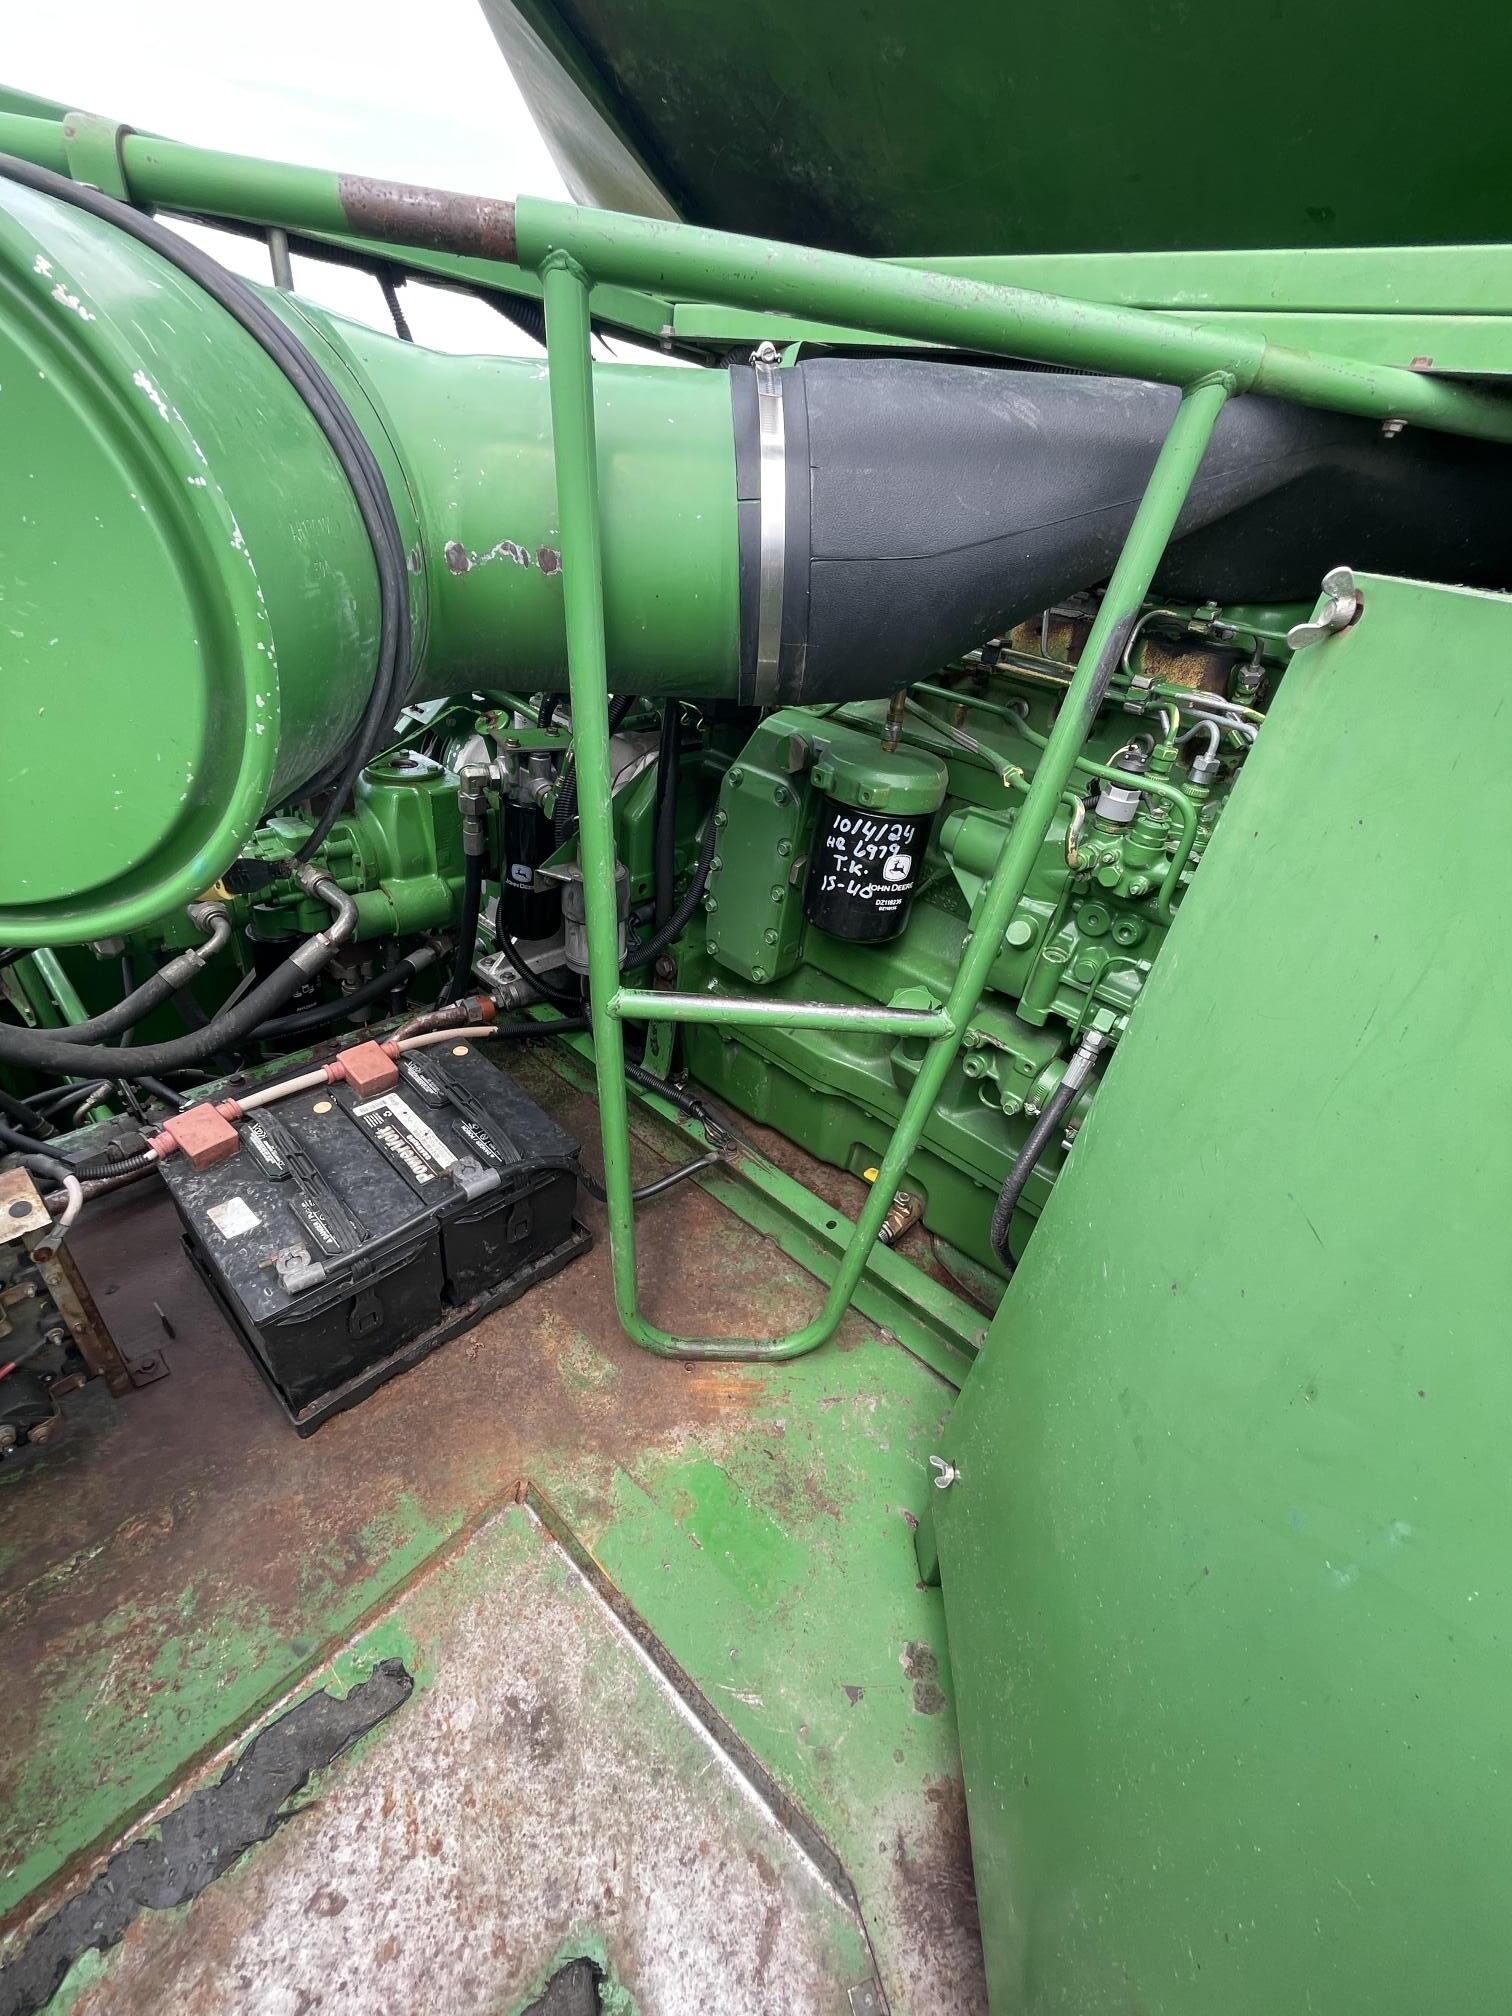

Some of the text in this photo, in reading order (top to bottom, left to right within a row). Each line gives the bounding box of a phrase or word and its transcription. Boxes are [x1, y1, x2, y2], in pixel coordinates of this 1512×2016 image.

[833, 814, 915, 845] 10/4/24
[868, 881, 914, 892] JOHN DEERE
